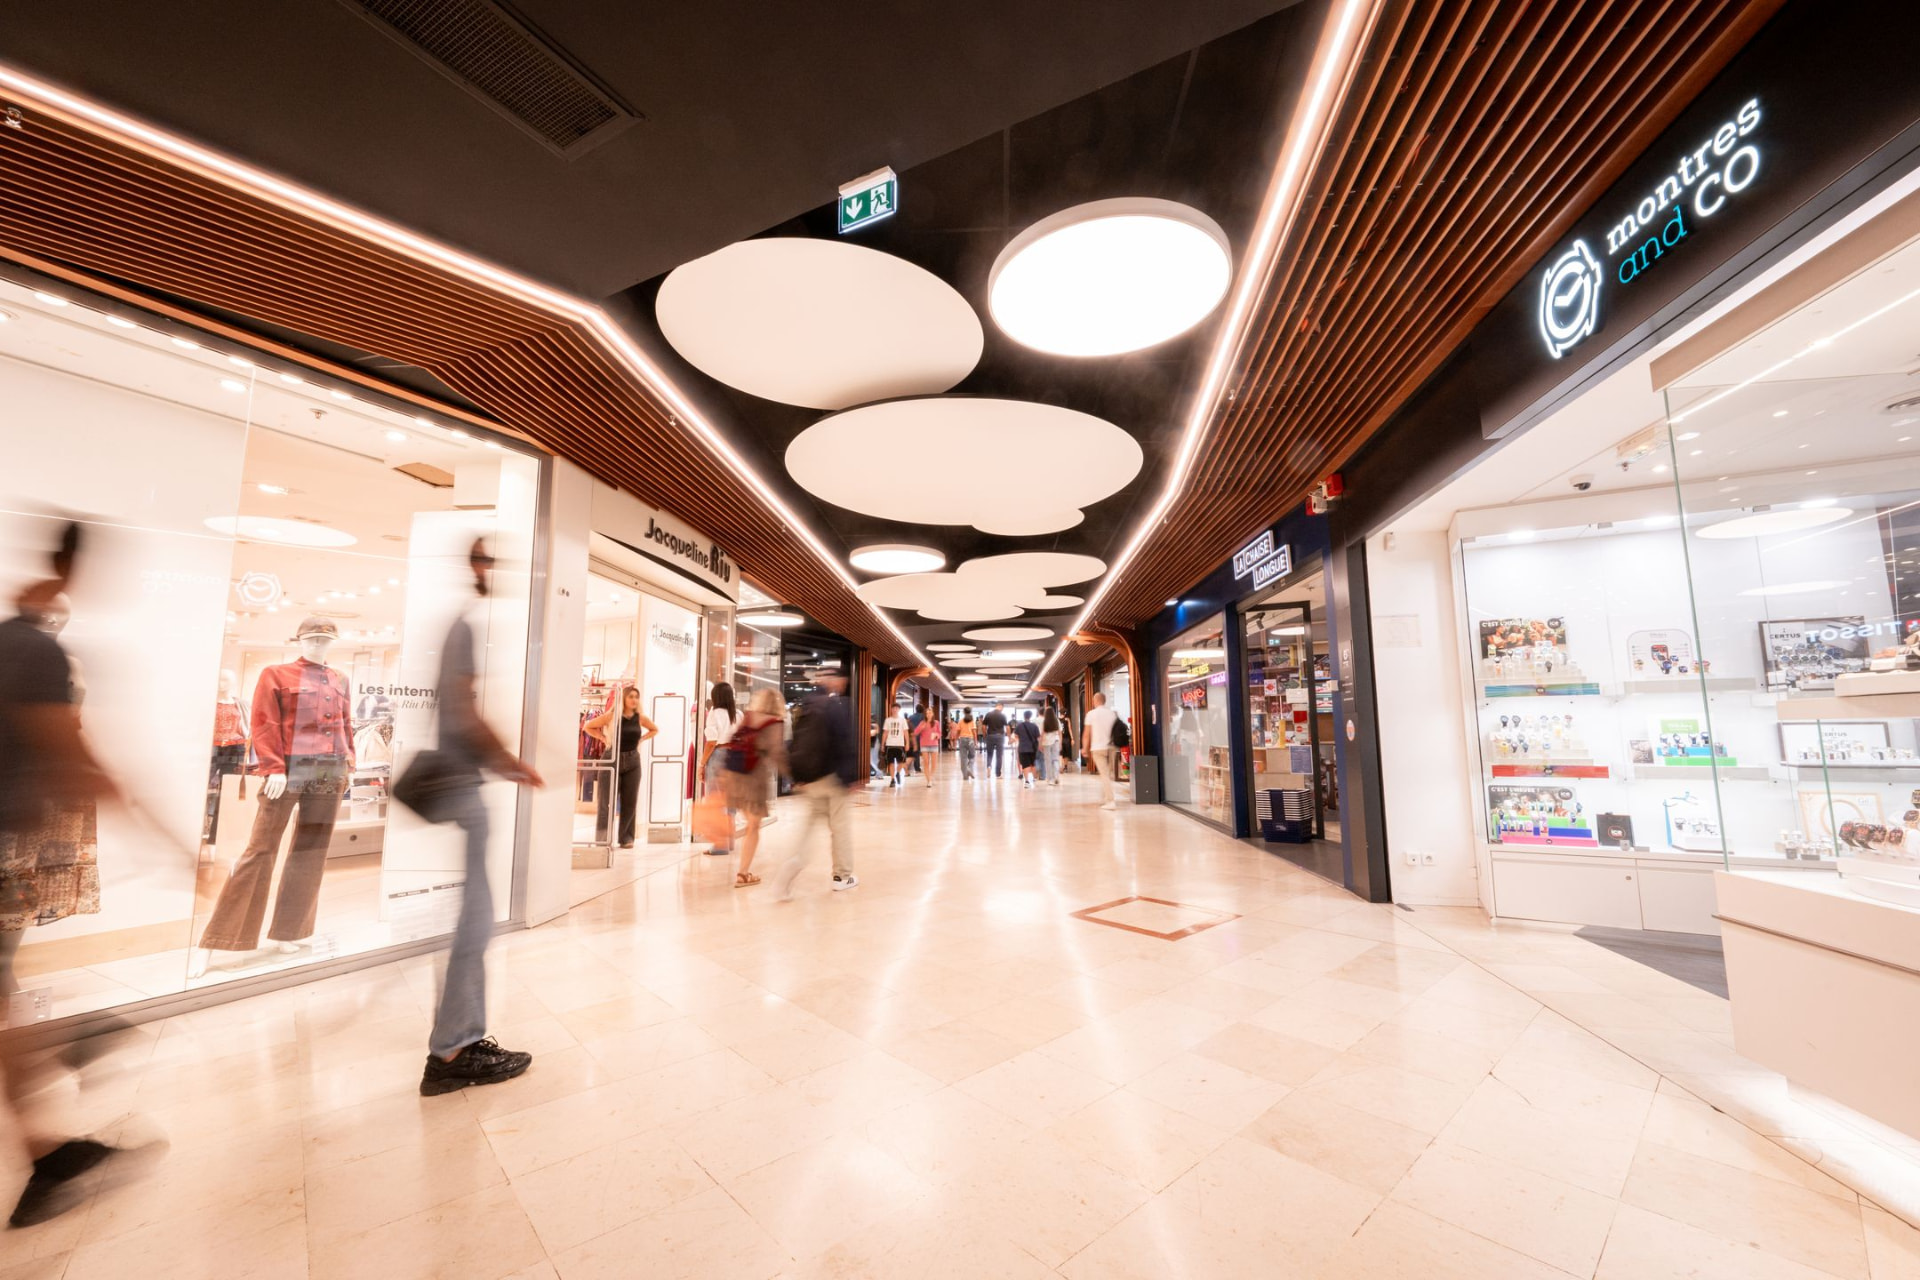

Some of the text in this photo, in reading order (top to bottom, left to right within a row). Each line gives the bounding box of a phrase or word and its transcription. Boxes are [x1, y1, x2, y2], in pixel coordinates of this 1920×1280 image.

[1606, 96, 1763, 256] montres
[1617, 206, 1689, 285] and
[644, 516, 709, 569] Jacqueline
[1235, 538, 1269, 573] LA CHAISE
[1255, 553, 1287, 584] LONGUE
[1769, 632, 1801, 640] CERTUS
[358, 683, 385, 695] Les
